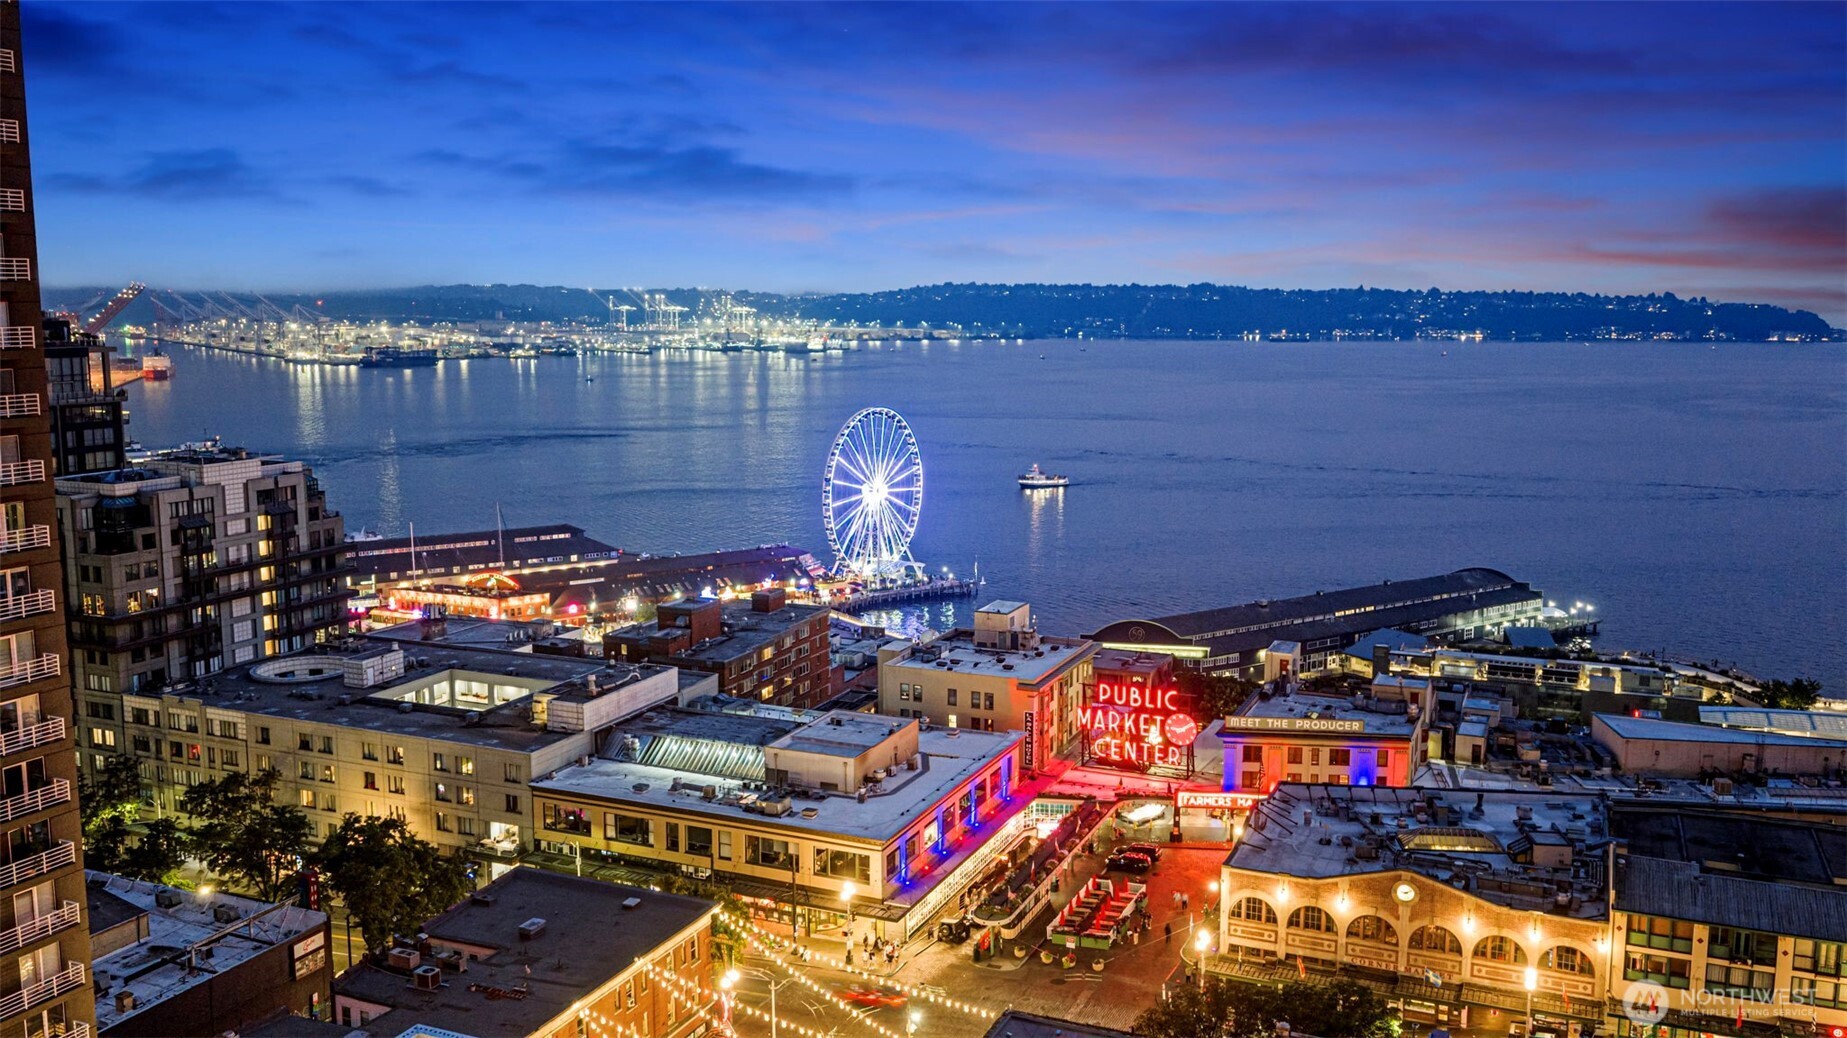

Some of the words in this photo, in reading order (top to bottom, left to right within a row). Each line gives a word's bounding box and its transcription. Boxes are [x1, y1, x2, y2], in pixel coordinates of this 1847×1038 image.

[1099, 683, 1178, 711] PUBLIC
[1077, 707, 1164, 735] MARKET
[1230, 717, 1261, 728] MEET
[1267, 719, 1289, 729] THE
[1295, 720, 1361, 731] PRODUCER
[1094, 738, 1181, 765] CENTER
[1183, 795, 1232, 807] FARMERS
[1351, 957, 1399, 971] CORNER
[1404, 966, 1453, 980] MAET
